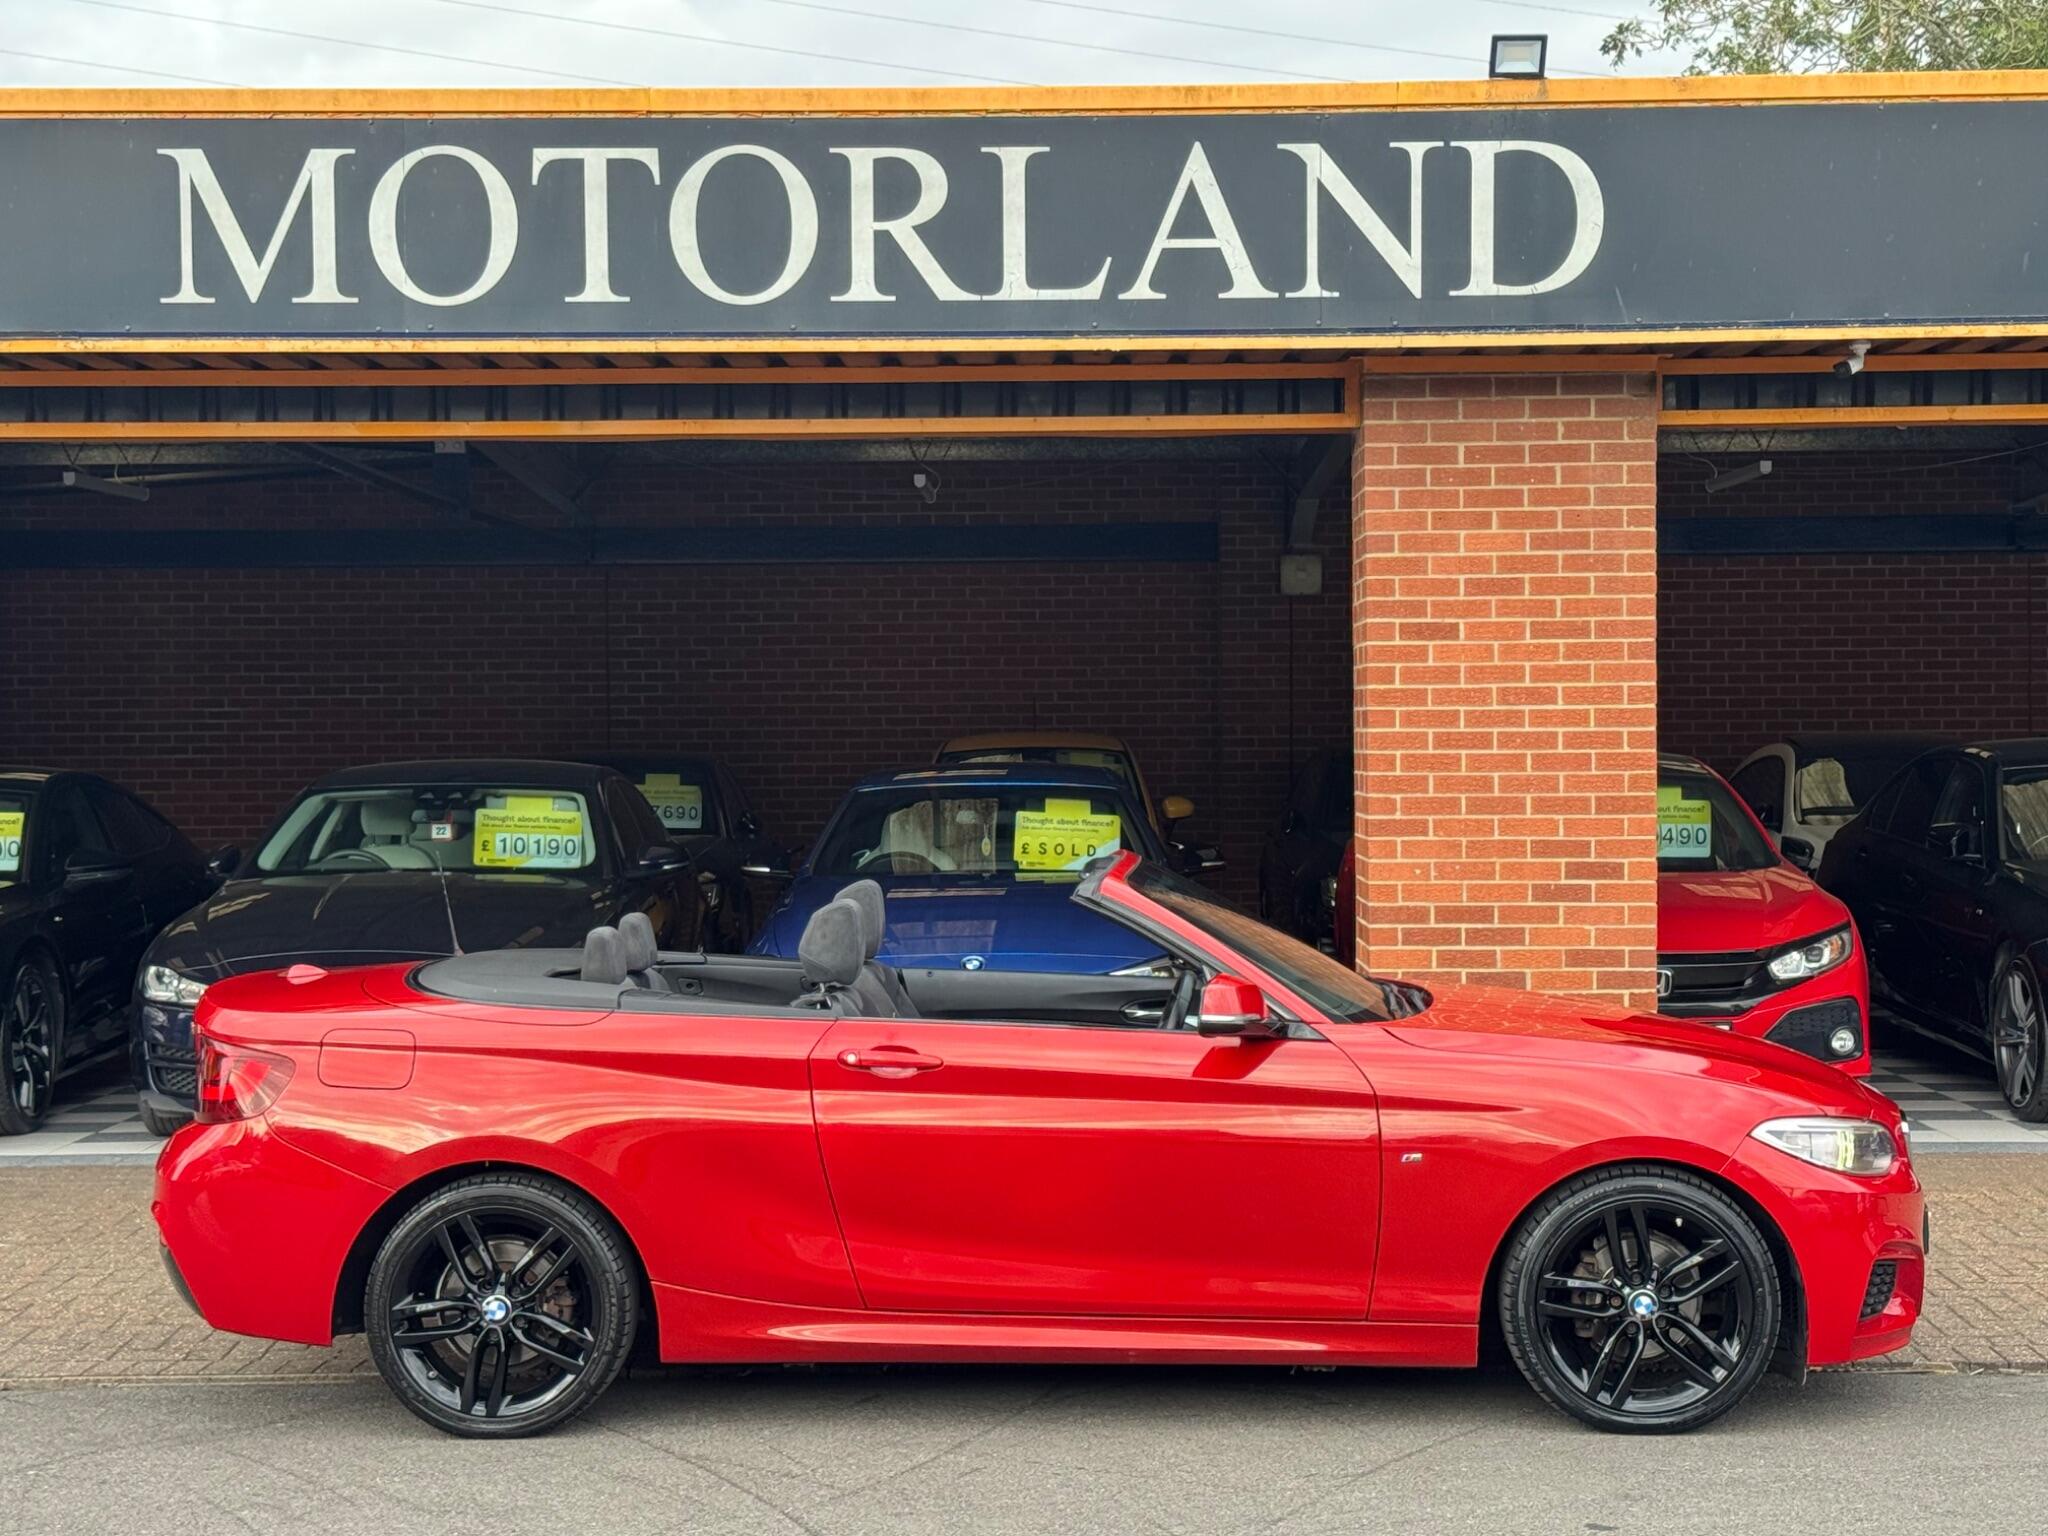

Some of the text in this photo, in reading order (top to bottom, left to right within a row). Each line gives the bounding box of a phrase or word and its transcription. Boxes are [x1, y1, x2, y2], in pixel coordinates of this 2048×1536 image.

[156, 139, 1605, 307] MOTORLAND
[1673, 805, 1706, 813] finance?
[481, 814, 577, 825] Thought about finance?
[1022, 816, 1115, 827] Thought about finance?
[1656, 827, 1707, 845] 490
[481, 837, 577, 856] £ 10190
[1021, 842, 1096, 857] £ SOLD
